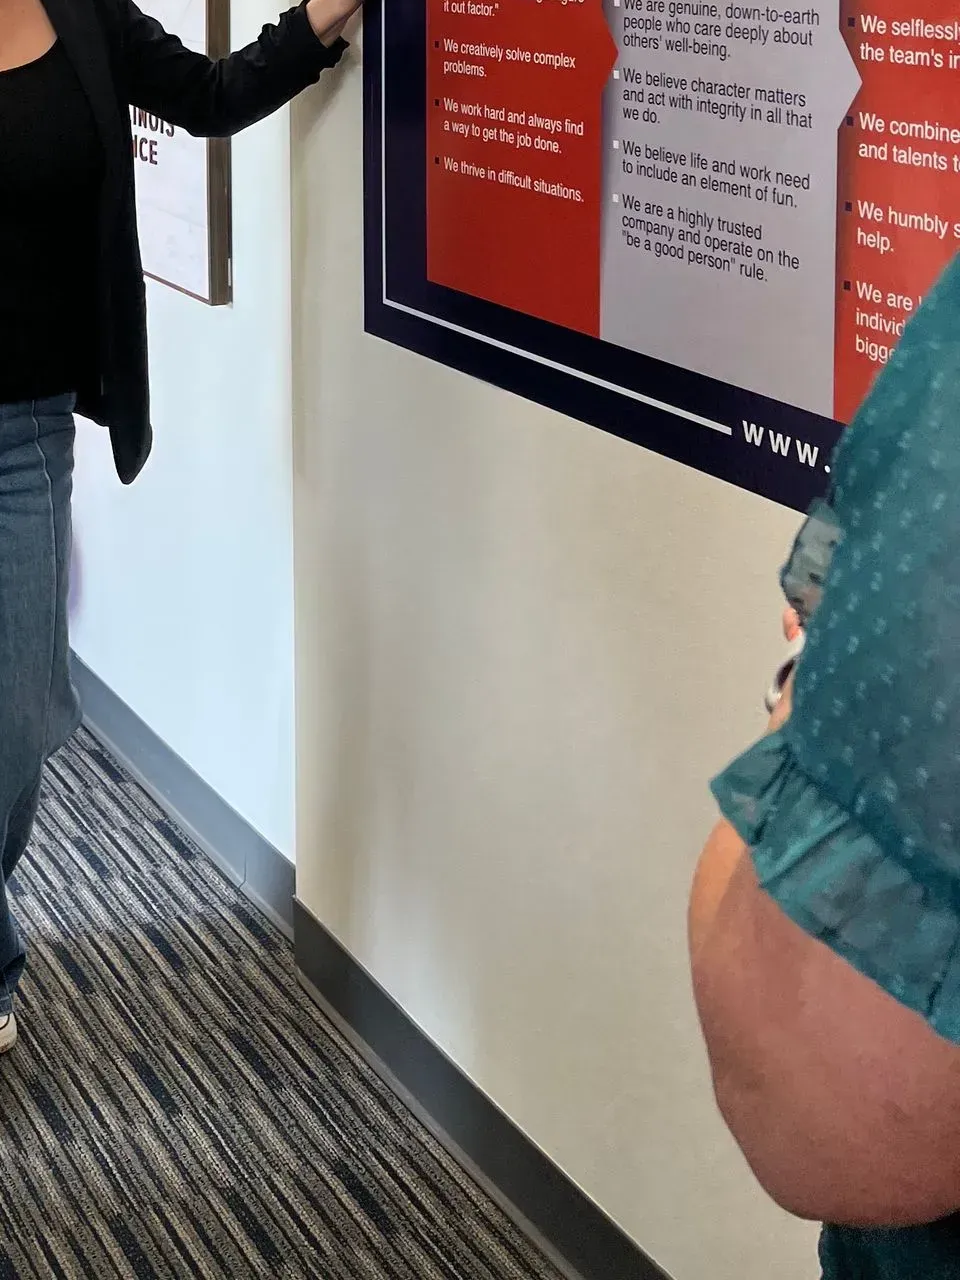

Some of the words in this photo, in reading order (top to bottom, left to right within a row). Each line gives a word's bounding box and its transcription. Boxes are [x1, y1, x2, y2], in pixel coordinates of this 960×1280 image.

[444, 0, 449, 12] it
[452, 3, 465, 13] out
[468, 1, 498, 16] factor."
[646, 0, 665, 12] are
[669, 0, 721, 19] genuine,
[726, 3, 819, 26] down-to-earth
[624, 16, 662, 34] people
[666, 19, 690, 33] who
[694, 23, 722, 37] care
[726, 23, 769, 46] deeply
[773, 29, 812, 46] about
[861, 14, 887, 34] We
[444, 38, 458, 52] We
[461, 44, 503, 62] creatively
[506, 48, 531, 62] solve
[534, 52, 576, 69] complex
[623, 34, 662, 49] others'
[666, 37, 731, 61] well-being.
[860, 42, 884, 62] the
[890, 45, 943, 68] team's
[444, 60, 487, 77] problems.
[623, 68, 642, 85] We
[646, 71, 687, 91] believe
[691, 77, 750, 99] character
[755, 87, 806, 107] matters
[444, 98, 458, 112] We
[461, 103, 481, 116] work
[484, 105, 505, 121] hard
[508, 111, 525, 125] and
[528, 114, 562, 134] always
[565, 119, 584, 136] find
[623, 86, 643, 102] and
[648, 91, 665, 106] act
[669, 94, 692, 110] with
[697, 97, 746, 122] integrity
[751, 106, 762, 120] in
[766, 107, 781, 124] all
[786, 110, 812, 129] that
[623, 107, 638, 120] we
[643, 108, 660, 123] do.
[859, 112, 884, 132] We
[890, 120, 959, 144] combine
[623, 140, 641, 157] We
[645, 144, 686, 165] believe
[690, 152, 708, 170] life
[712, 159, 735, 176] and
[740, 164, 771, 183] work
[776, 171, 810, 190] need
[859, 143, 887, 160] and
[892, 145, 947, 170] talents
[444, 157, 458, 172] We
[461, 161, 485, 179] thrive
[488, 167, 496, 181] in
[498, 170, 531, 190] difficult
[534, 179, 584, 202] situations.
[623, 194, 640, 211] We
[645, 201, 663, 217] are
[667, 206, 674, 220] a
[678, 206, 713, 232] highly
[718, 216, 762, 240] trusted
[858, 200, 883, 221] We
[889, 207, 948, 239] humbly
[857, 227, 894, 253] help.
[856, 281, 882, 304] We
[887, 292, 913, 311] are
